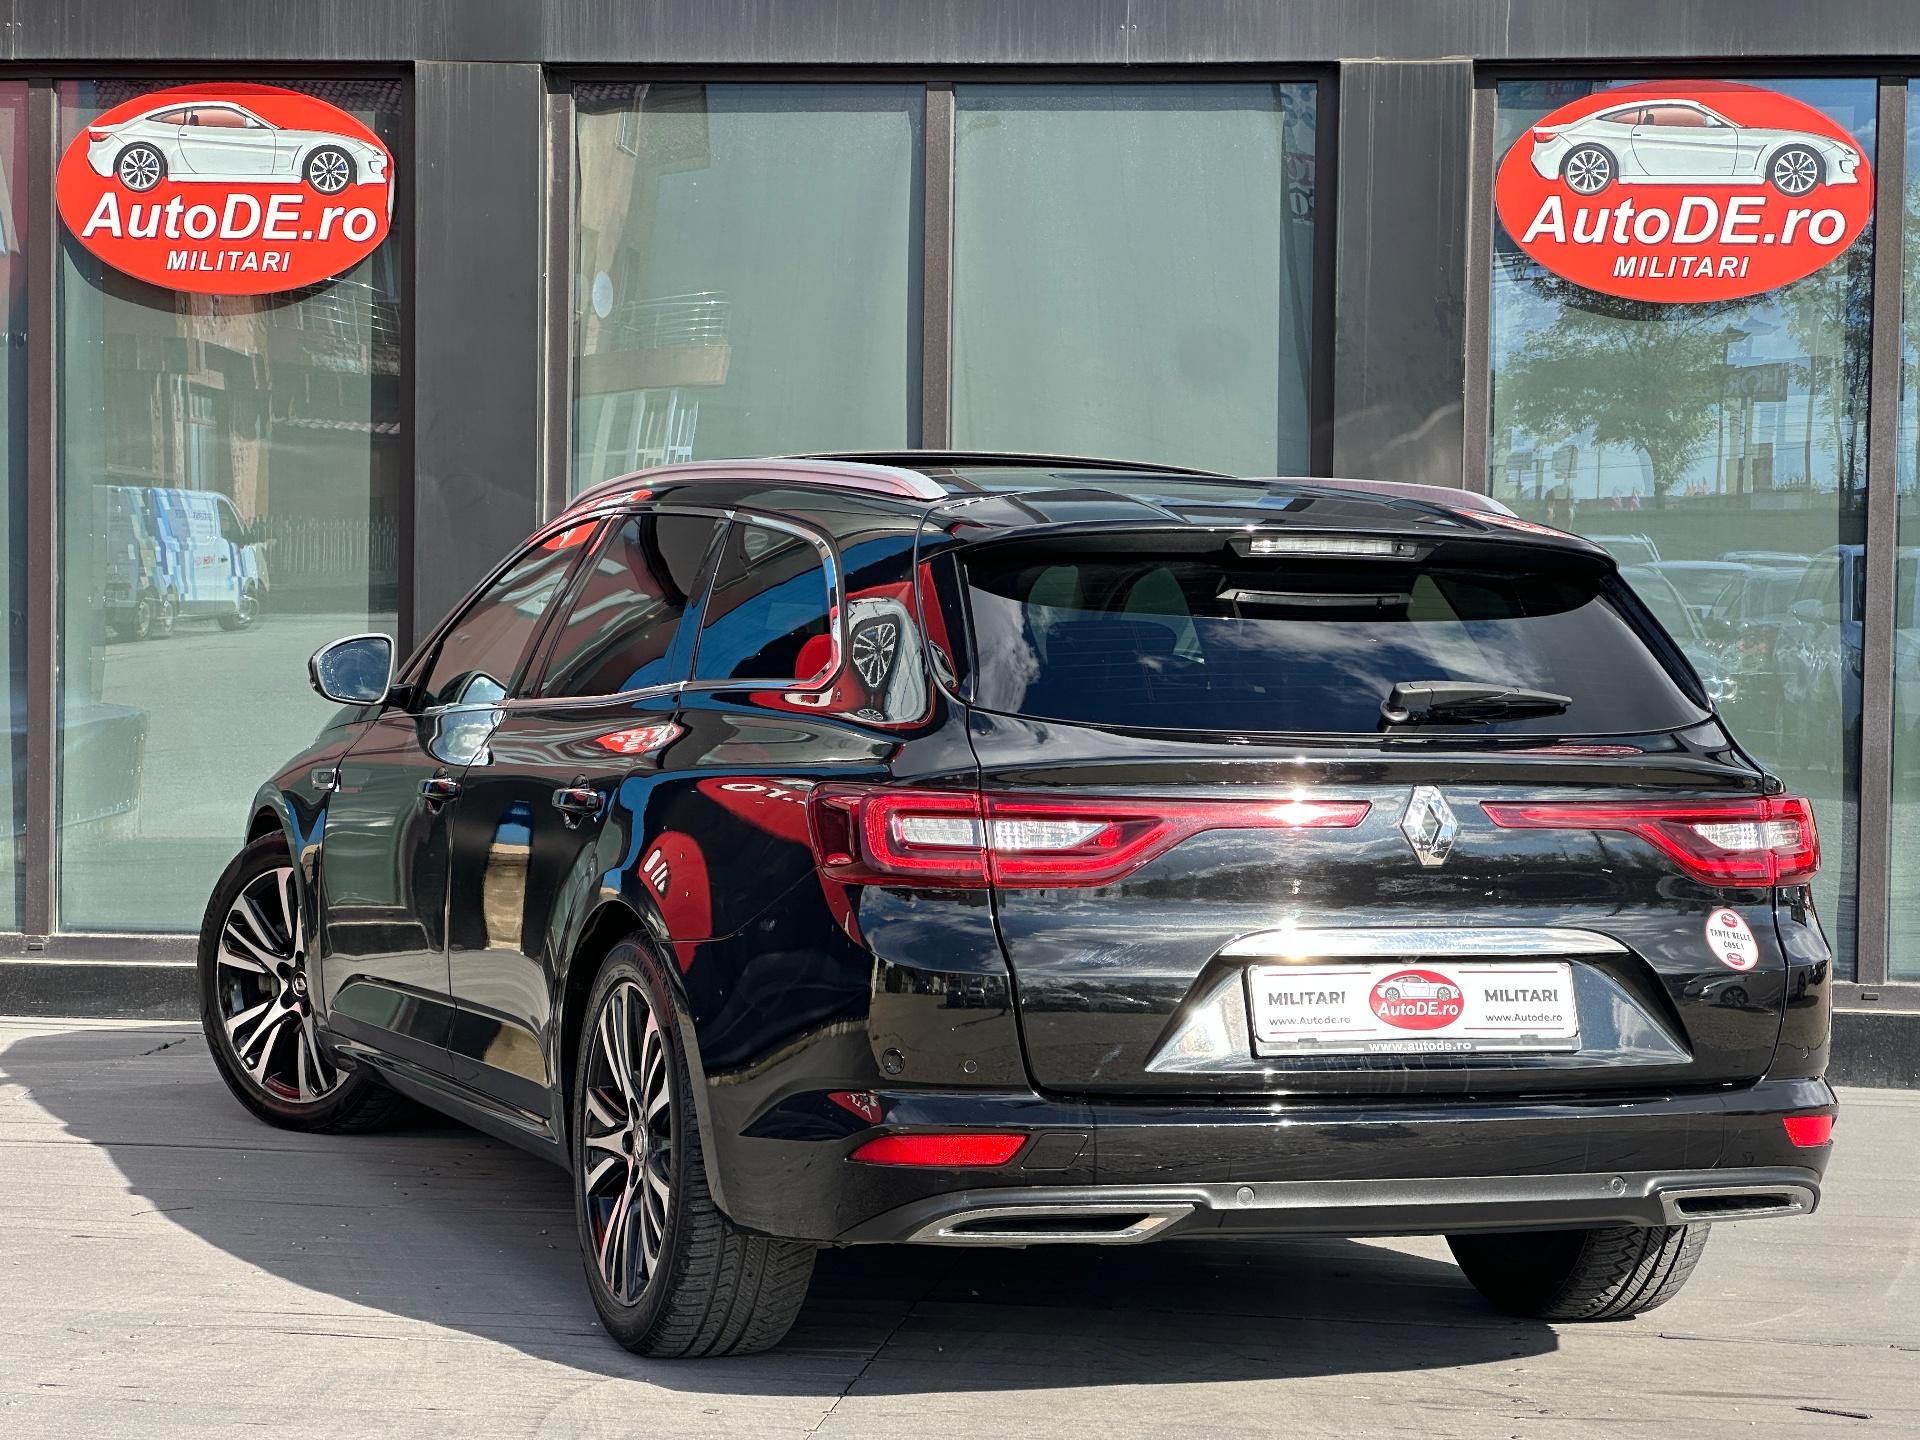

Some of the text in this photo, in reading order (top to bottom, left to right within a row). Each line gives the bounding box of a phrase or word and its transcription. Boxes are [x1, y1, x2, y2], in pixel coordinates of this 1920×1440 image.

[81, 191, 378, 243] AutoDE.ro
[1521, 195, 1847, 246] AutoDE.ro
[166, 249, 291, 272] MILITARI
[1612, 256, 1750, 279] MILITARI
[1709, 929, 1731, 938] TANTE
[1268, 991, 1346, 1006] MILITARI
[1484, 989, 1559, 1002] MILITARI
[1376, 1001, 1459, 1017] AutoDE.ro
[1269, 1015, 1351, 1026] www.Autode.ro
[1485, 1013, 1563, 1022] www.Autode.ro
[1368, 1040, 1472, 1051] www.autode.ro
